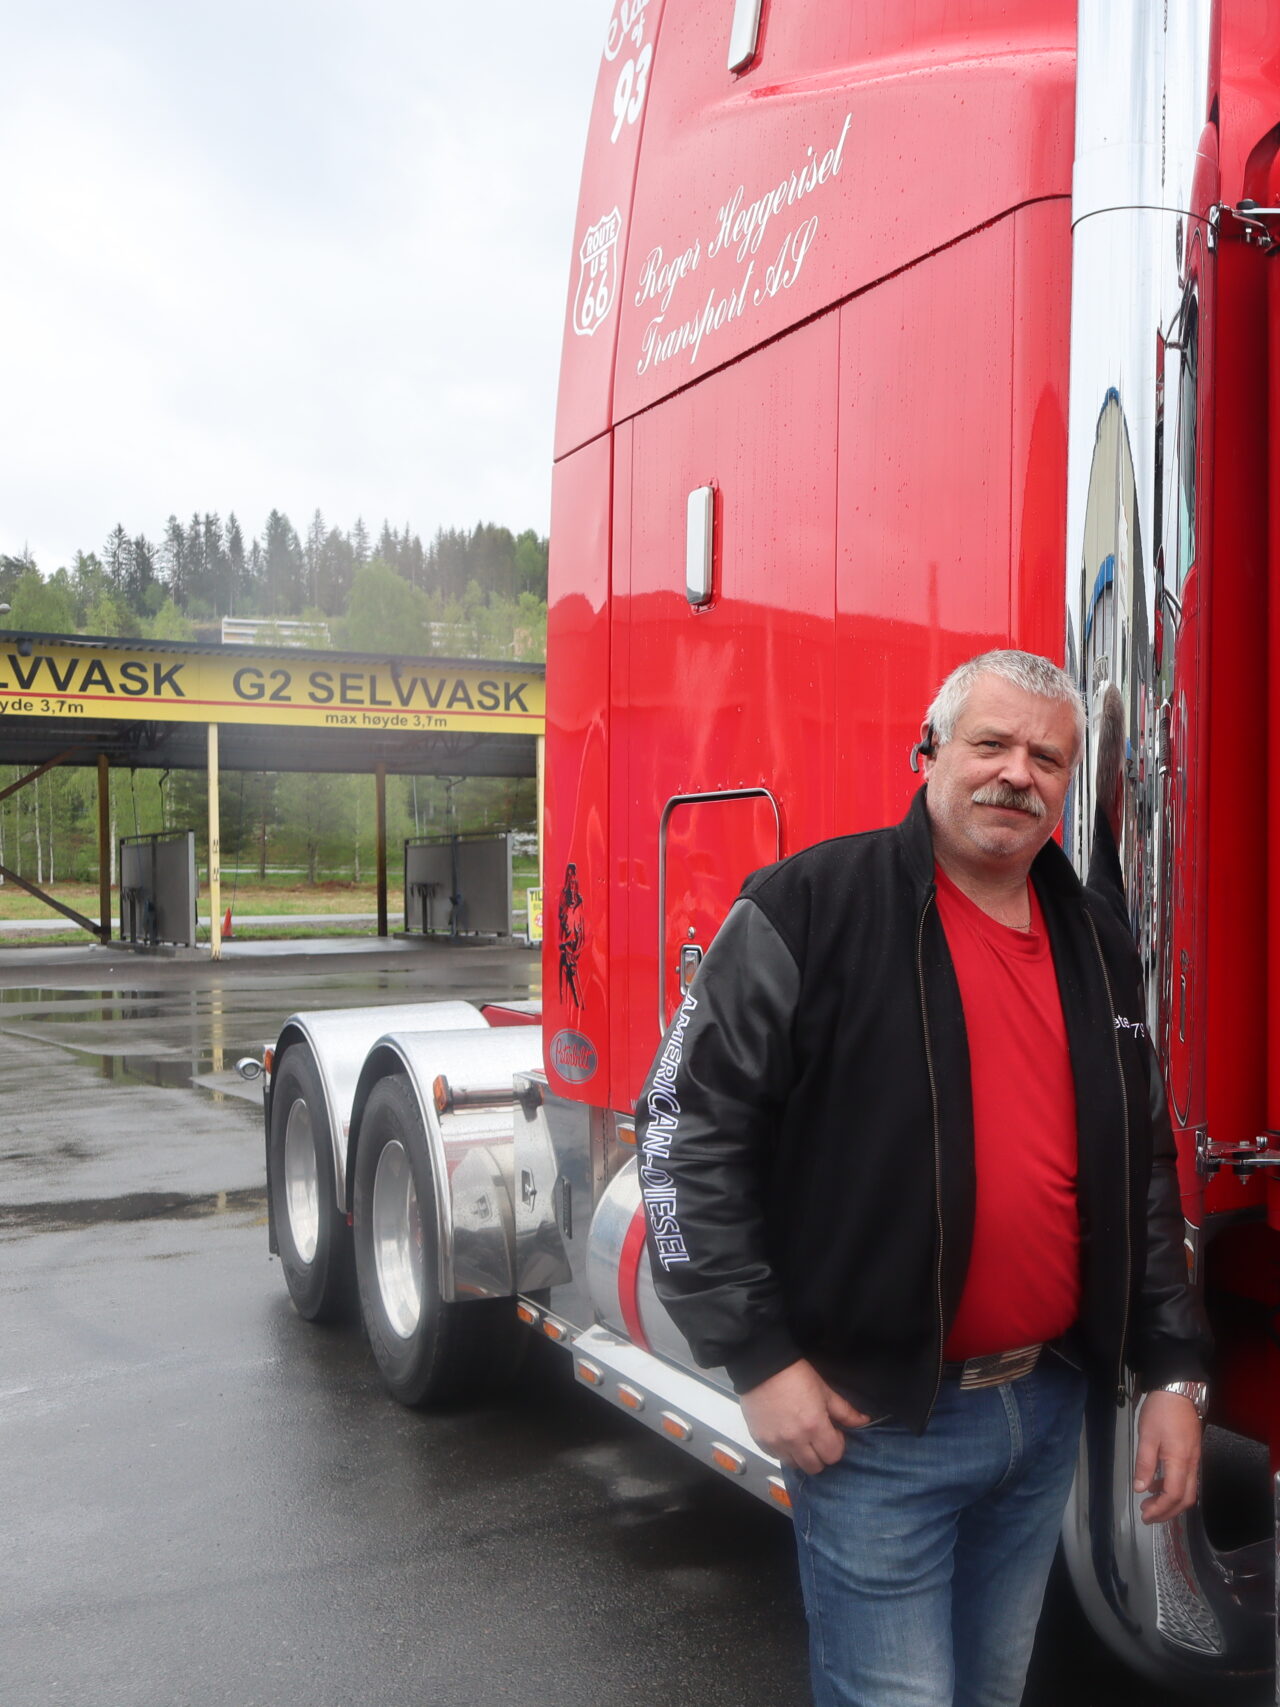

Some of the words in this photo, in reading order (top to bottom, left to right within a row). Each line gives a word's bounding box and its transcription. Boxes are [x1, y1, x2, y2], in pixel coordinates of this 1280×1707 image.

[611, 43, 653, 144] 93
[587, 217, 616, 257] ROUTE
[590, 249, 609, 279] US
[635, 239, 701, 313] Roger
[581, 269, 609, 328] 66
[637, 260, 755, 376] Transport
[753, 215, 819, 306] AS
[0, 653, 187, 698] VVASK
[232, 667, 292, 703] G2
[307, 671, 530, 713] SELVVASK
[40, 698, 84, 714] 3,7m
[325, 714, 357, 725] max
[362, 713, 409, 728] høyde
[413, 715, 447, 729] 3,7m
